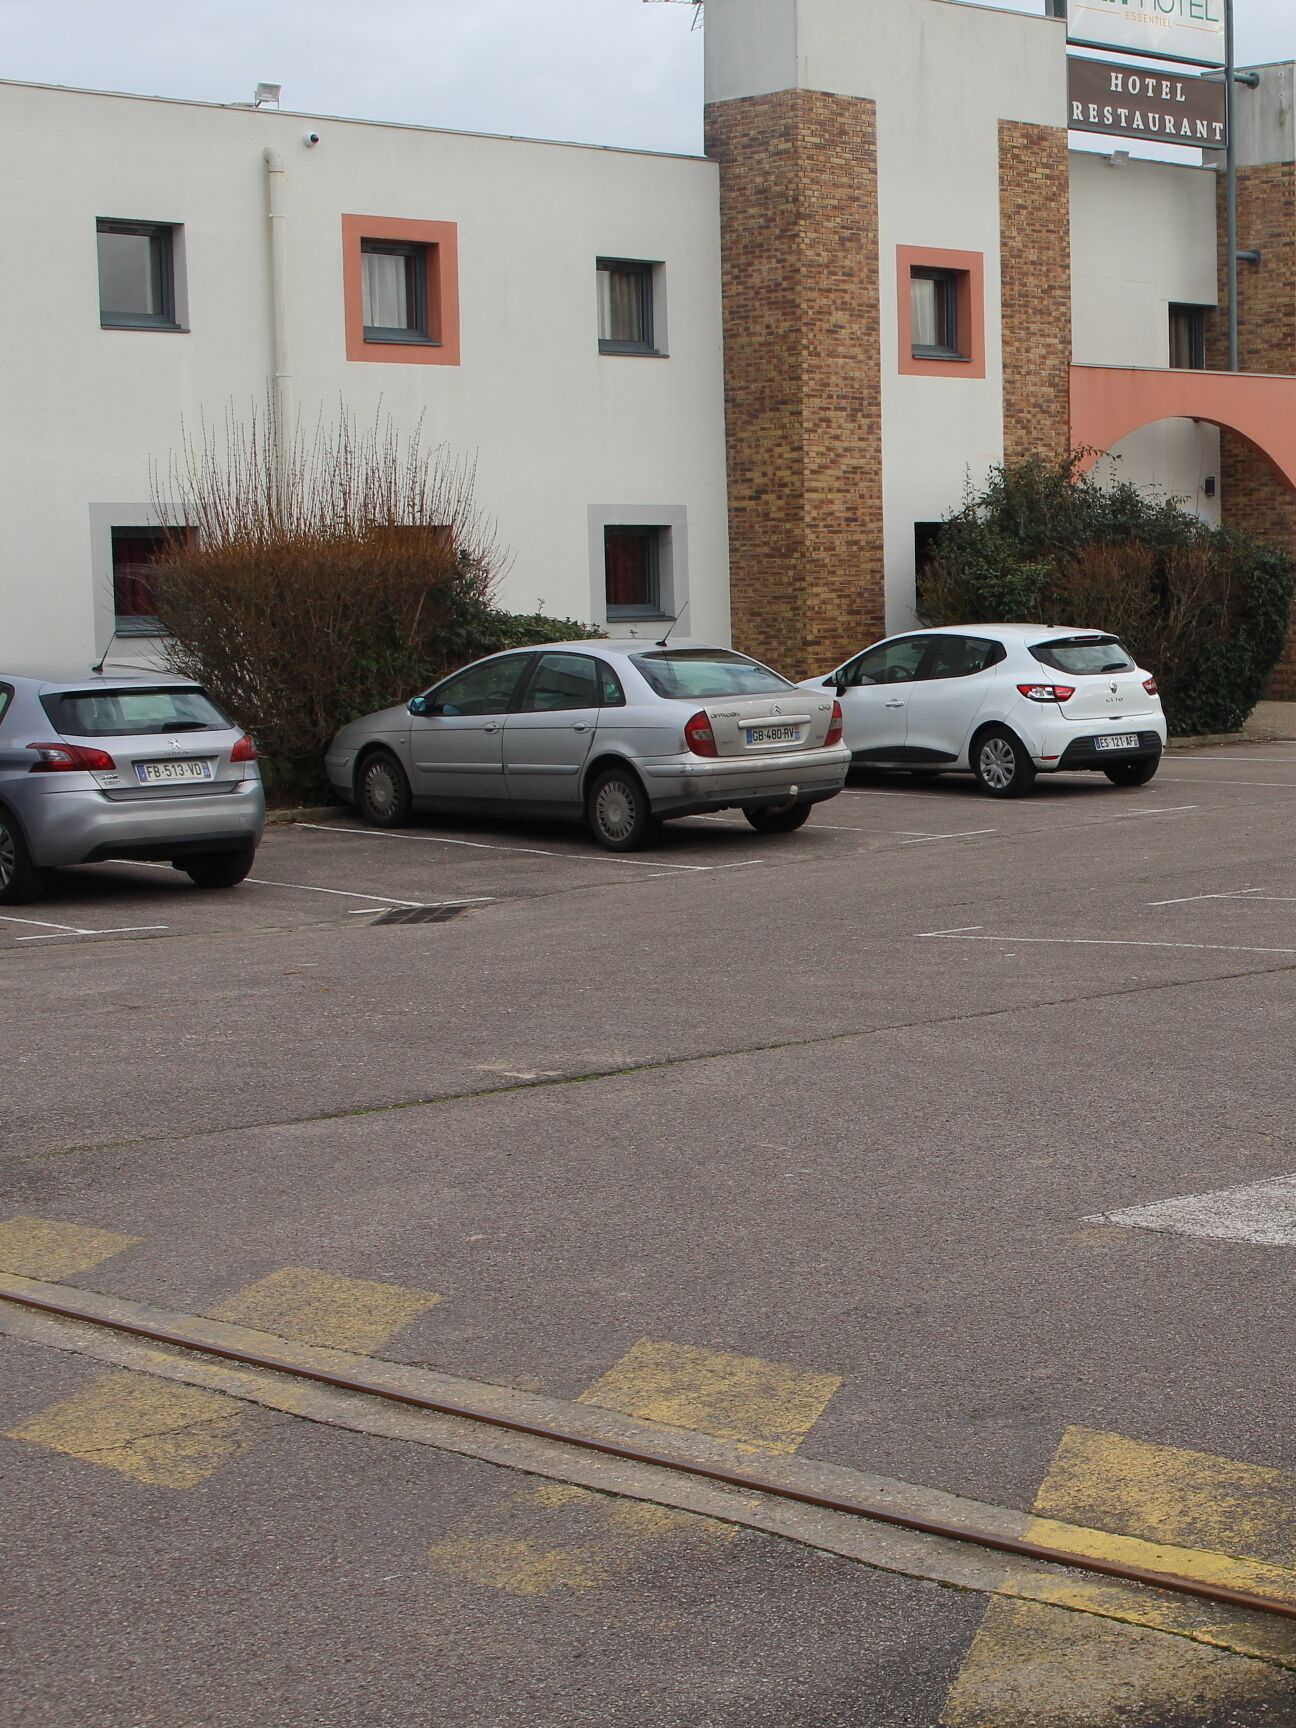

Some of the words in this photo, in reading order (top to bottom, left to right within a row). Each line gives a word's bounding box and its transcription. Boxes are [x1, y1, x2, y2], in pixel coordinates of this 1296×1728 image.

[1125, 11, 1173, 28] ESSENTIEL
[1110, 72, 1186, 102] HOTEL
[1072, 101, 1224, 141] RESTAURANT
